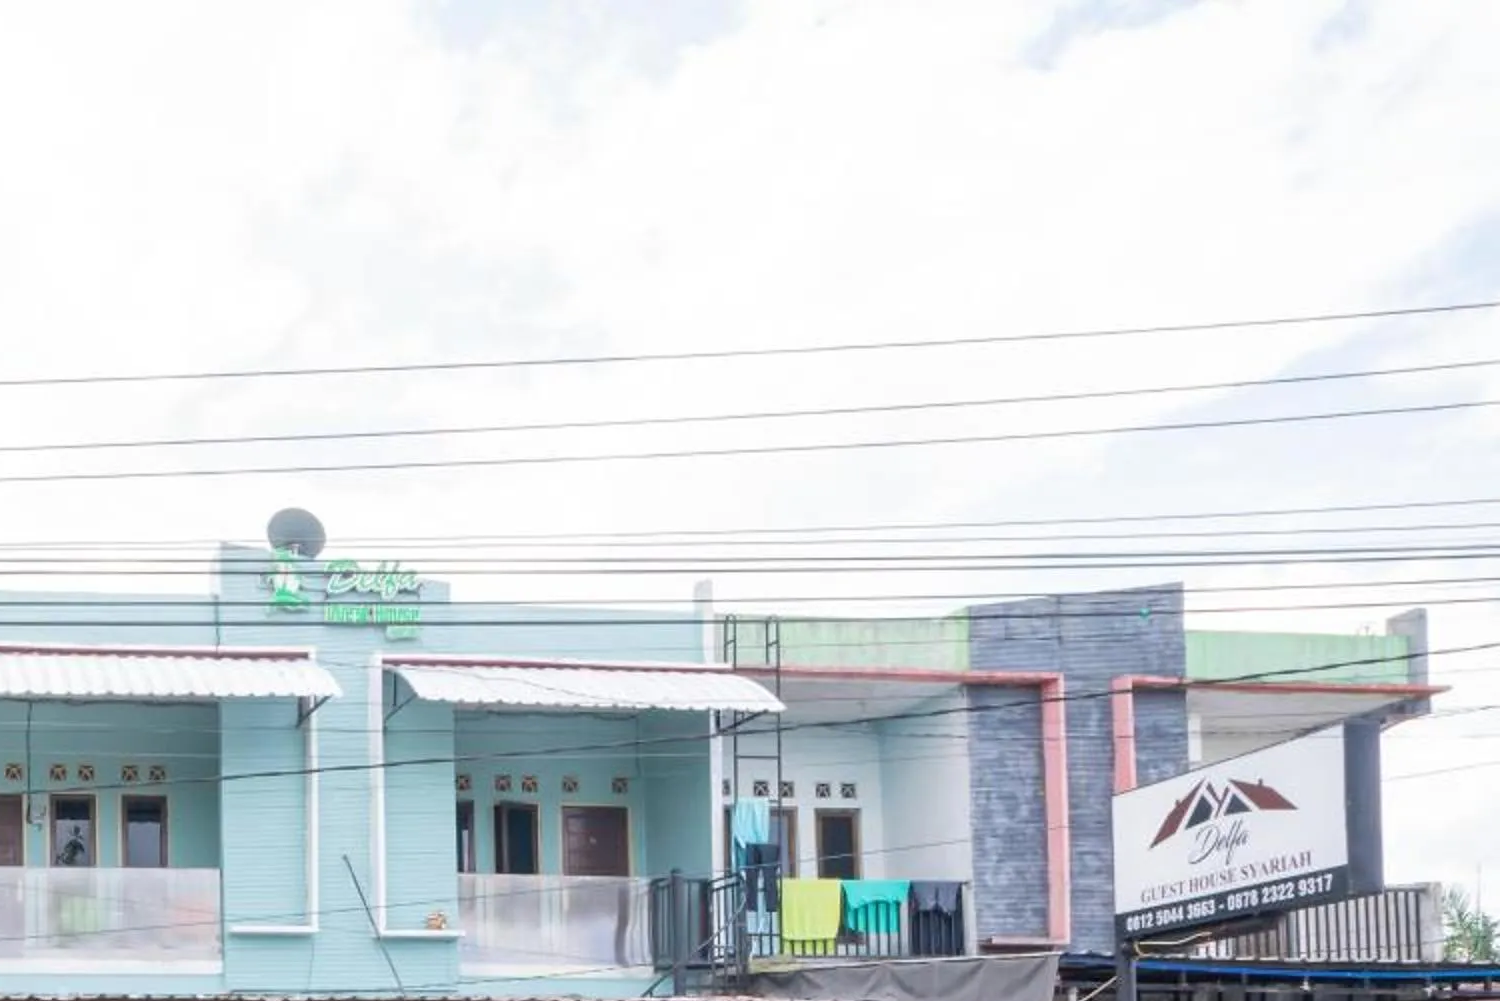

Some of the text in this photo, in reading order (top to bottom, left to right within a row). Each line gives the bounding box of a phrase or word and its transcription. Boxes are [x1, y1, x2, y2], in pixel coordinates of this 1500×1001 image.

[1189, 816, 1249, 866] Delfa
[1140, 850, 1311, 904] GUEST HOUSE SYARIAH
[1155, 905, 1184, 926] 5044
[1261, 881, 1295, 904] 2322
[1297, 873, 1333, 897] 9317
